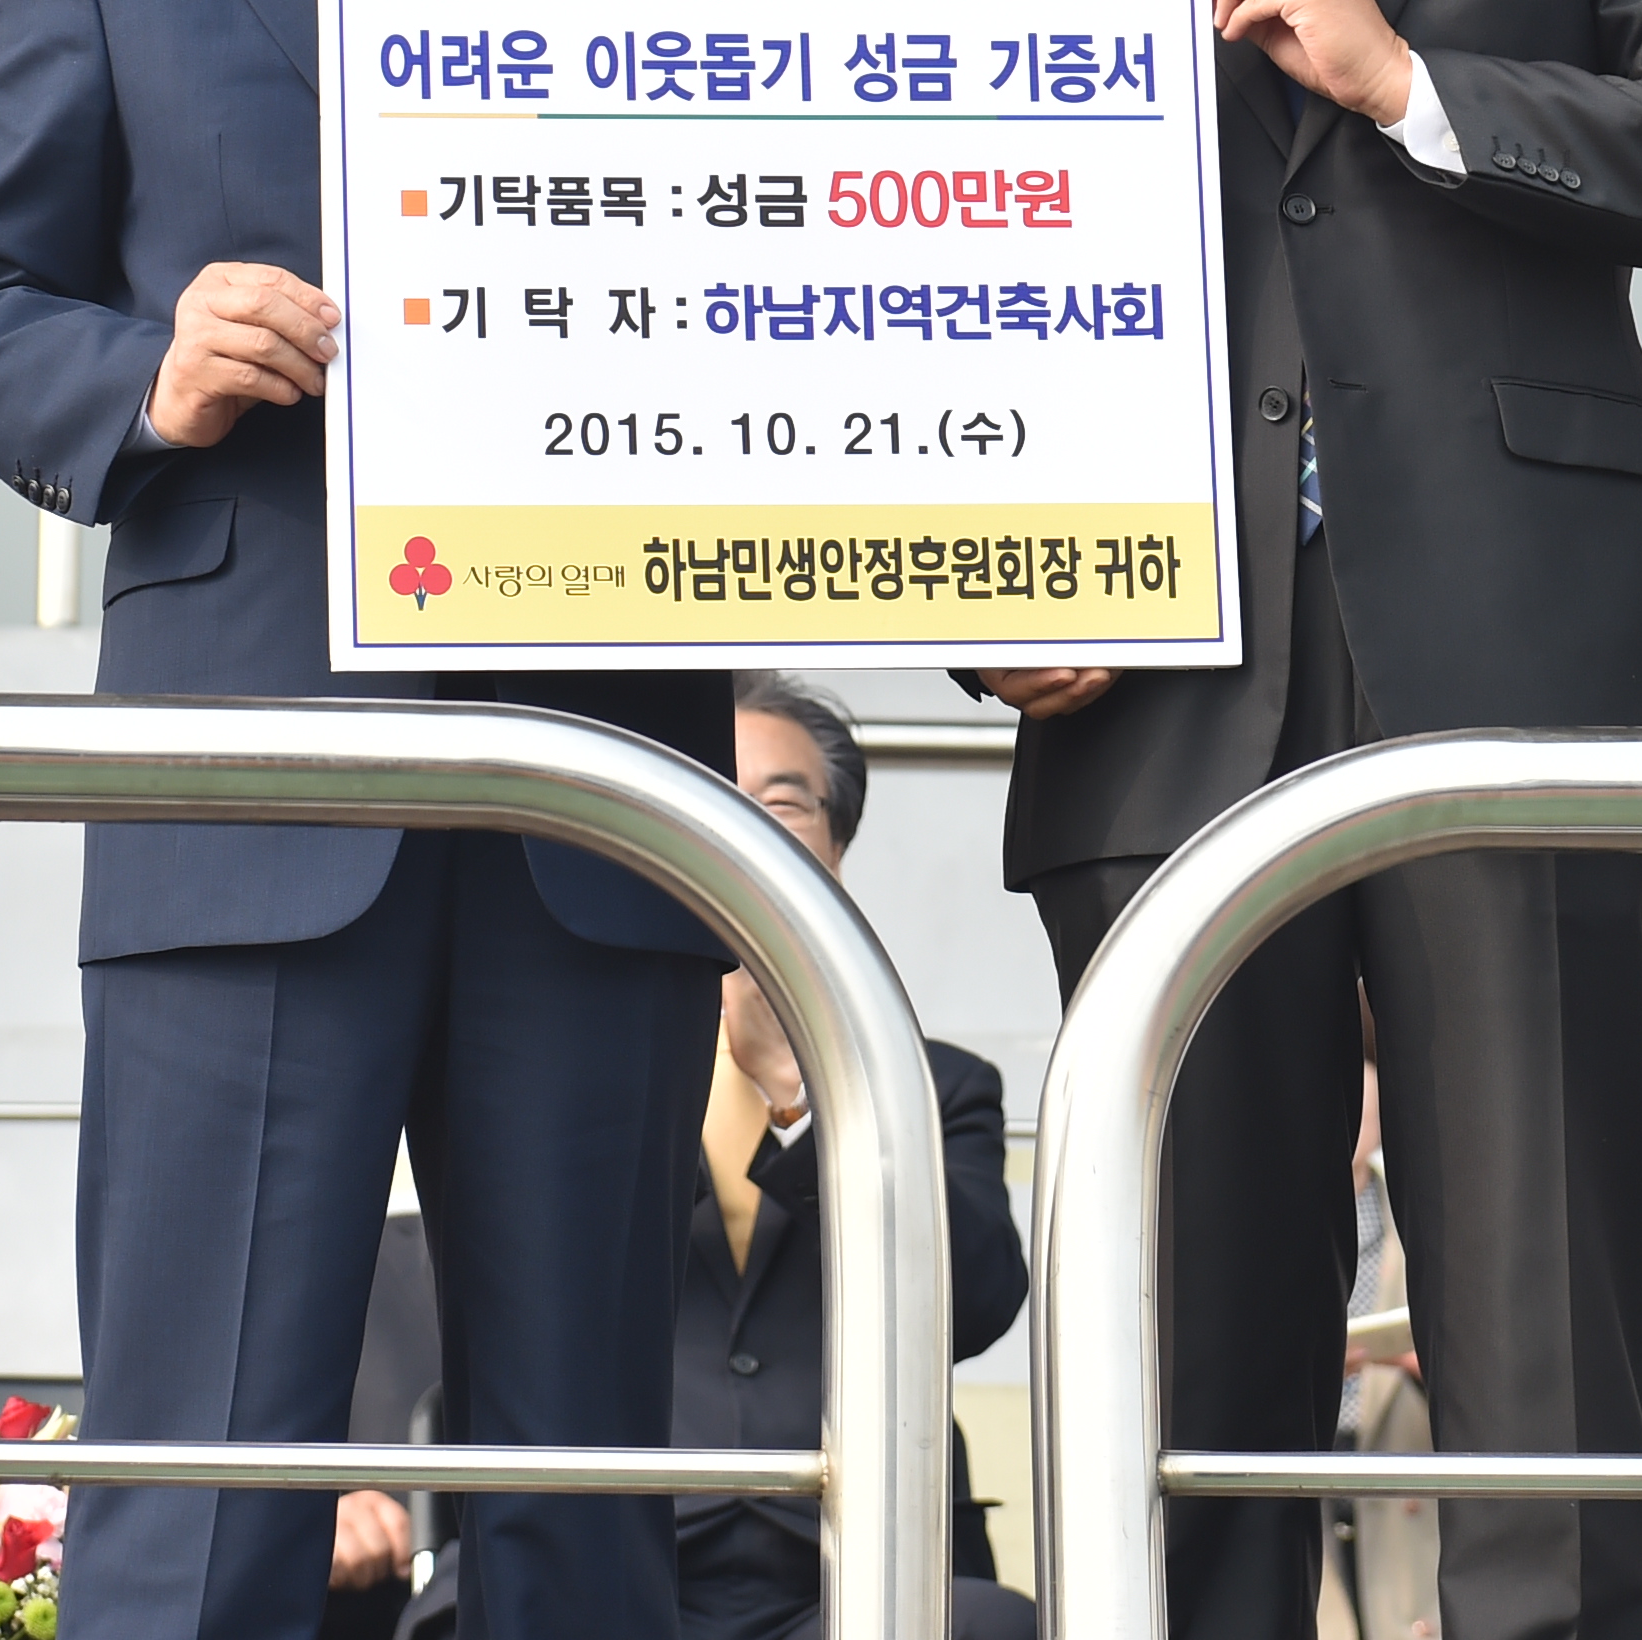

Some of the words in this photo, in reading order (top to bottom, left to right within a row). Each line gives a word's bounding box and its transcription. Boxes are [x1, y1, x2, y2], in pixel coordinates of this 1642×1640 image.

[381, 30, 553, 100] 어려운
[586, 31, 811, 101] 이웃돕기
[844, 33, 957, 102] 성금
[989, 33, 1155, 103] 기증서
[440, 175, 646, 226] 기탁품목
[697, 174, 807, 227] 성금
[828, 170, 1072, 228] 500만원
[704, 282, 1163, 341] 하남지역건축사회
[545, 413, 702, 455] 2015.
[731, 413, 815, 455] 10.
[844, 409, 1025, 457] 21.(수)
[644, 535, 1081, 601] 하남민생안정후원회장
[1095, 534, 1181, 599] 귀하
